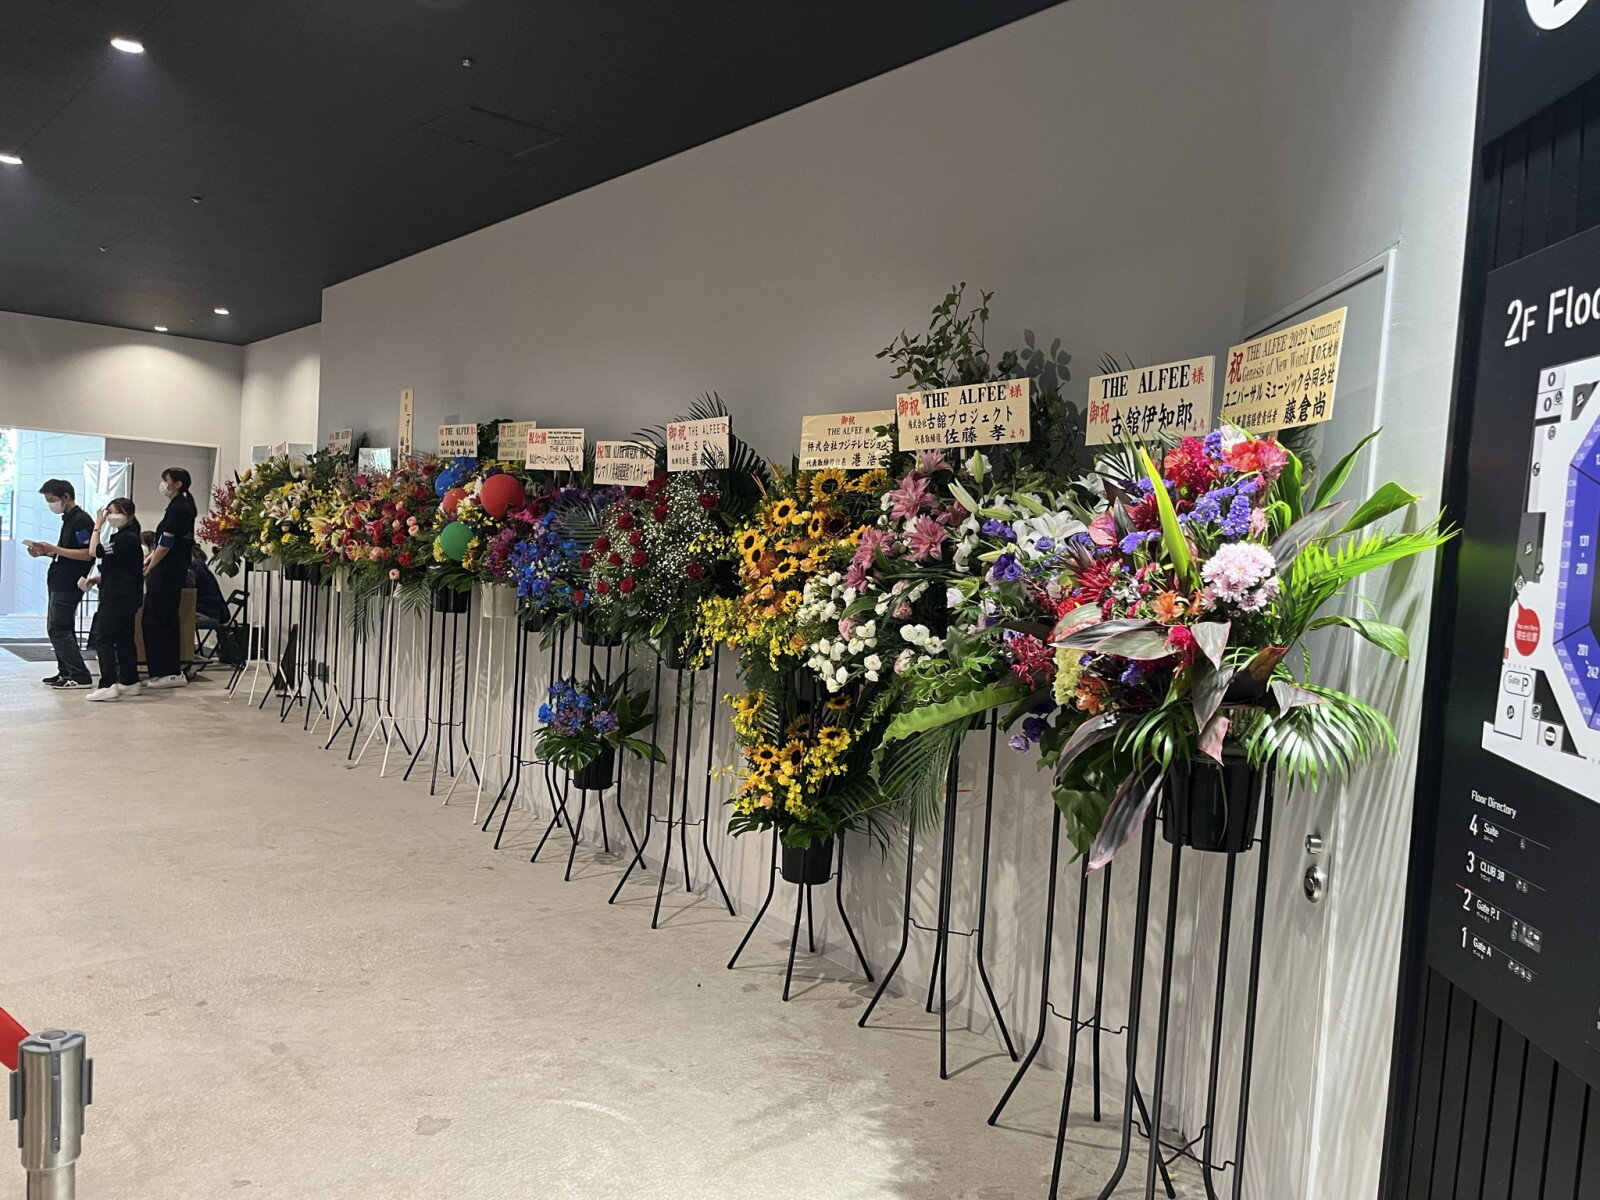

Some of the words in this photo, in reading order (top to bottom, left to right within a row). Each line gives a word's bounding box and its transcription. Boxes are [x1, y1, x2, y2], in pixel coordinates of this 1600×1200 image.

[1504, 299, 1538, 347] 2F
[1246, 343, 1261, 363] THE
[1262, 334, 1287, 357] ALFEE
[1289, 327, 1308, 349] 2022
[1309, 320, 1341, 342] Summer
[1228, 352, 1243, 385] 祝
[1241, 362, 1264, 382] Genesis
[1266, 358, 1274, 375] of
[1274, 355, 1288, 373] New
[1290, 348, 1309, 367] World
[1102, 375, 1129, 399] THE
[1138, 364, 1190, 394] ALFEE
[1192, 365, 1204, 384] 様
[898, 396, 920, 417] 御祝
[923, 391, 949, 409] THE
[959, 384, 1006, 405] ALFEE
[1009, 384, 1023, 398] 様
[841, 415, 855, 425] 御祝
[1089, 401, 1110, 425] 御祝
[668, 425, 686, 441] 御祝
[688, 426, 698, 436] THE
[702, 424, 720, 435] ALFEE
[827, 427, 840, 436] THE
[842, 426, 863, 435] ALFEE
[1508, 675, 1520, 685] Gate
[1521, 677, 1529, 692] P
[1471, 790, 1487, 804] Floor
[1487, 796, 1517, 819] Directory
[1469, 814, 1478, 836] 4
[1484, 822, 1499, 838] Suite
[1466, 851, 1475, 873] 3
[1480, 861, 1496, 877] CLUB
[1463, 888, 1471, 911] 2
[1477, 900, 1490, 914] Gate
[1462, 927, 1467, 948] 1
[1473, 937, 1486, 953] Gate
[1486, 946, 1492, 957] A
